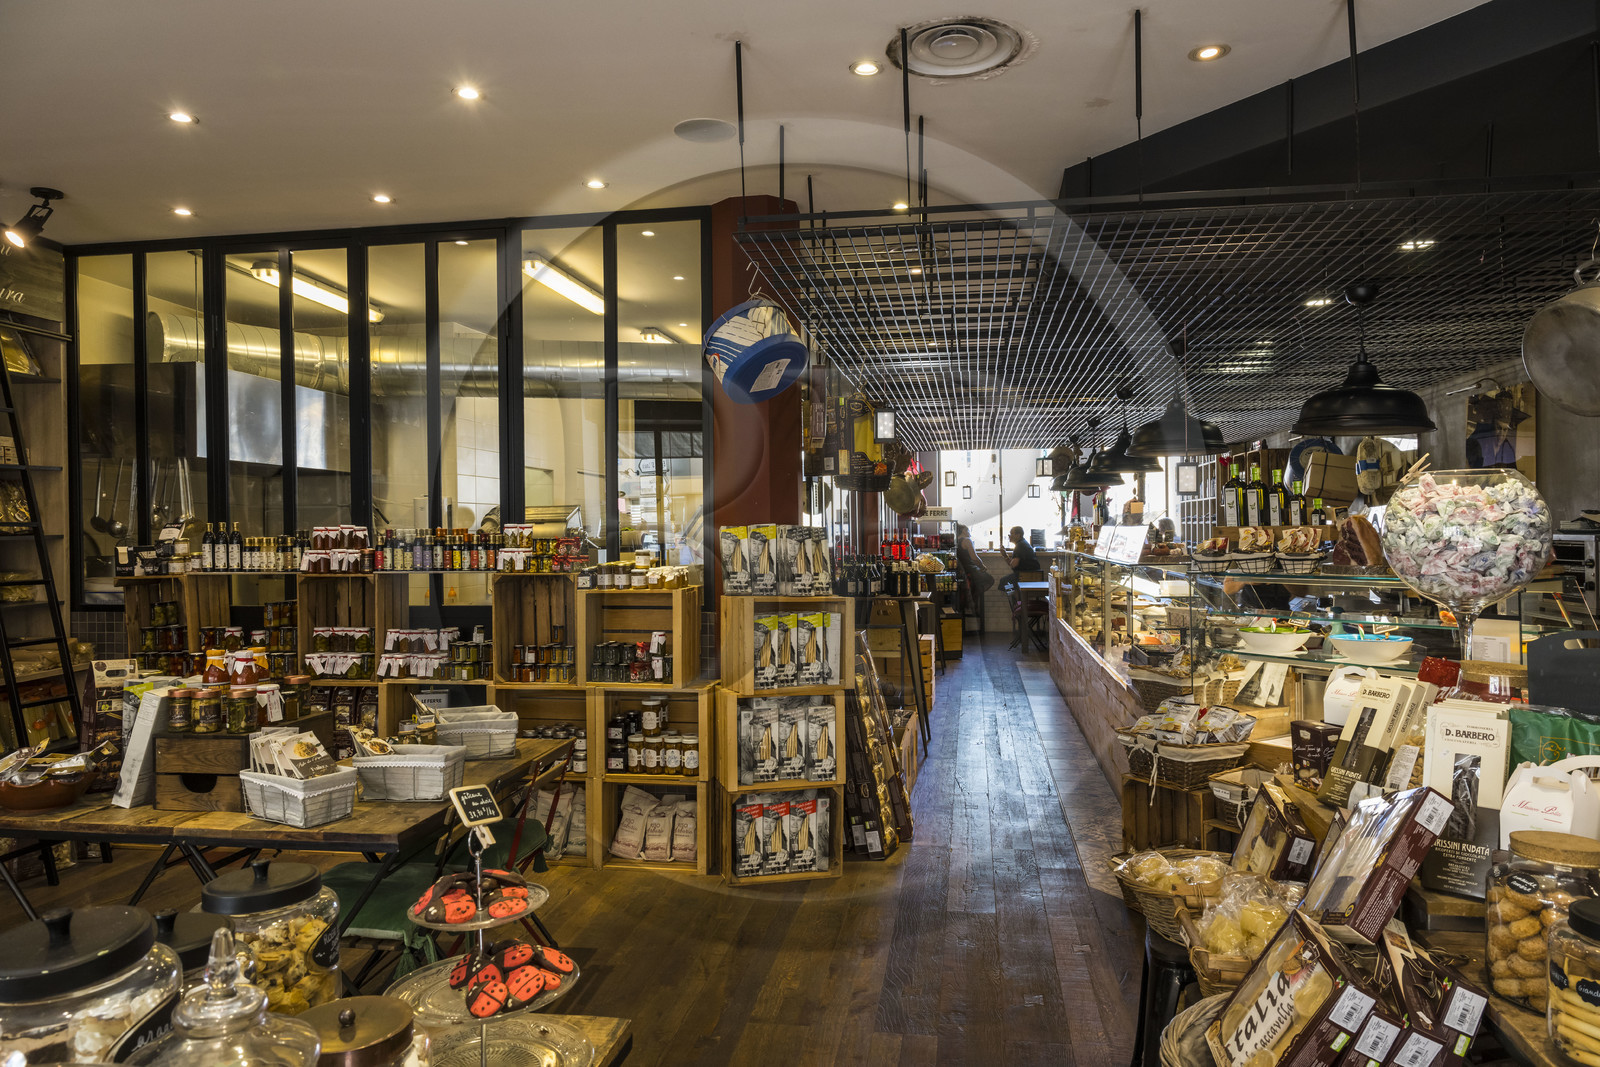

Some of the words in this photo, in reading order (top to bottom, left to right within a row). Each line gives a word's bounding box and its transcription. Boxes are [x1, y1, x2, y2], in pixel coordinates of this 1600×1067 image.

[1367, 689, 1391, 699] BARBERO
[1455, 729, 1495, 741] BARBERO
[1461, 843, 1490, 857] RUBATÀ
